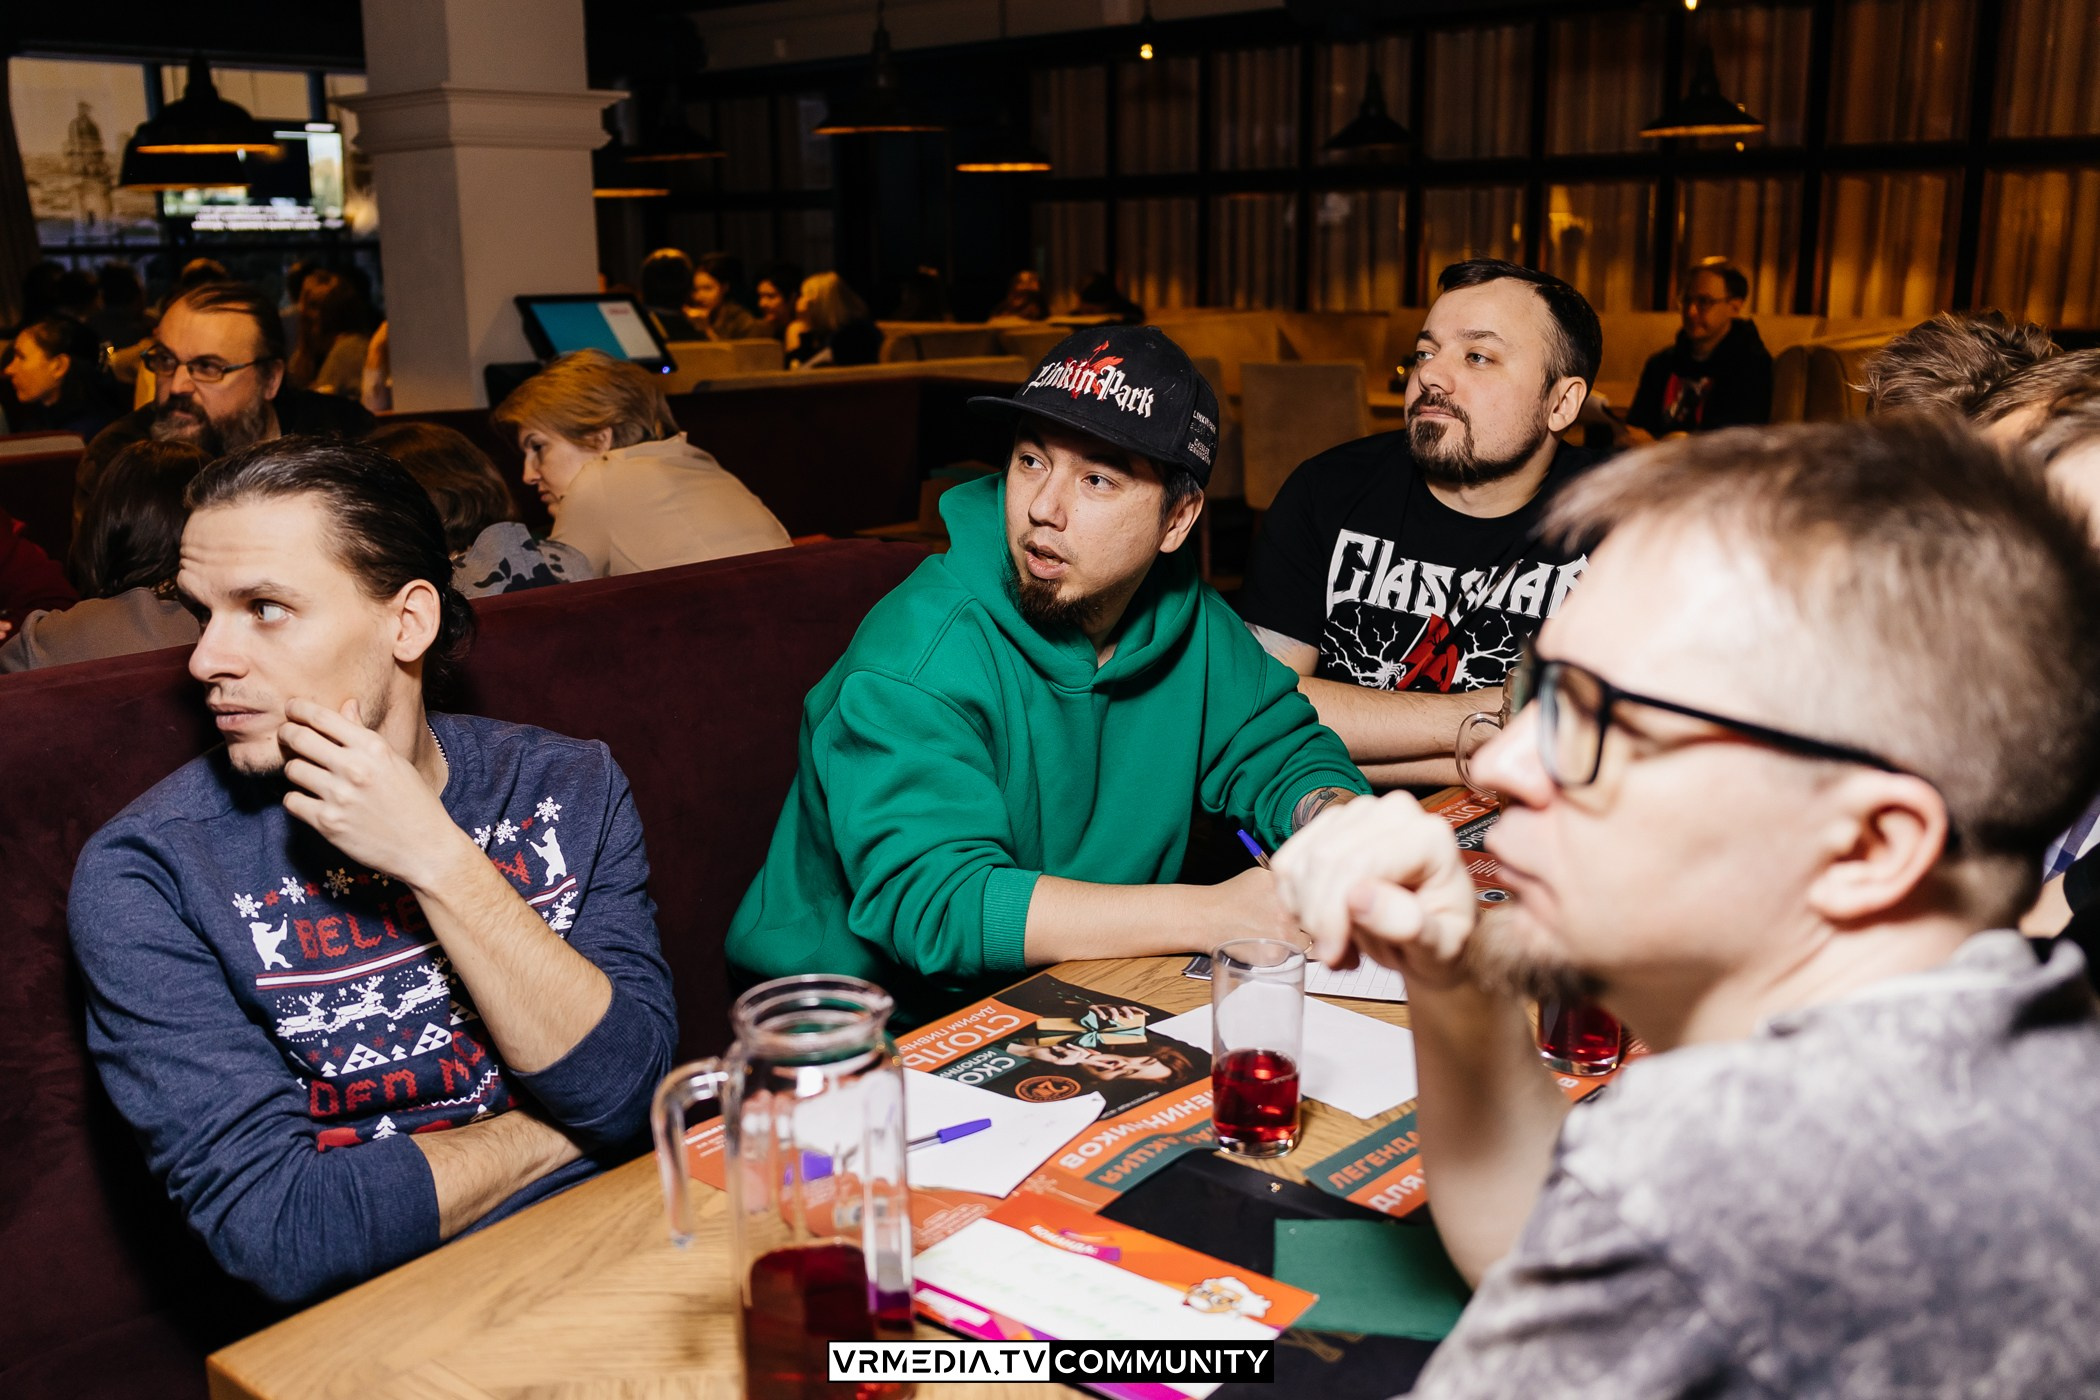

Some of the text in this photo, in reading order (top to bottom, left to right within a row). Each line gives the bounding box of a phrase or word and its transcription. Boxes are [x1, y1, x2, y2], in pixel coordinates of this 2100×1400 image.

[1097, 364, 1155, 418] Park
[898, 1005, 997, 1054] ДАРИМ ПИВНЫ
[901, 1014, 1020, 1067] СТОЛЬ
[939, 1050, 997, 1079] ИСПОЛНИ
[957, 1056, 1016, 1085] СКО
[1058, 1089, 1215, 1169] ЕНИННИКОВ
[1097, 1135, 1180, 1184] АКЦИЯ
